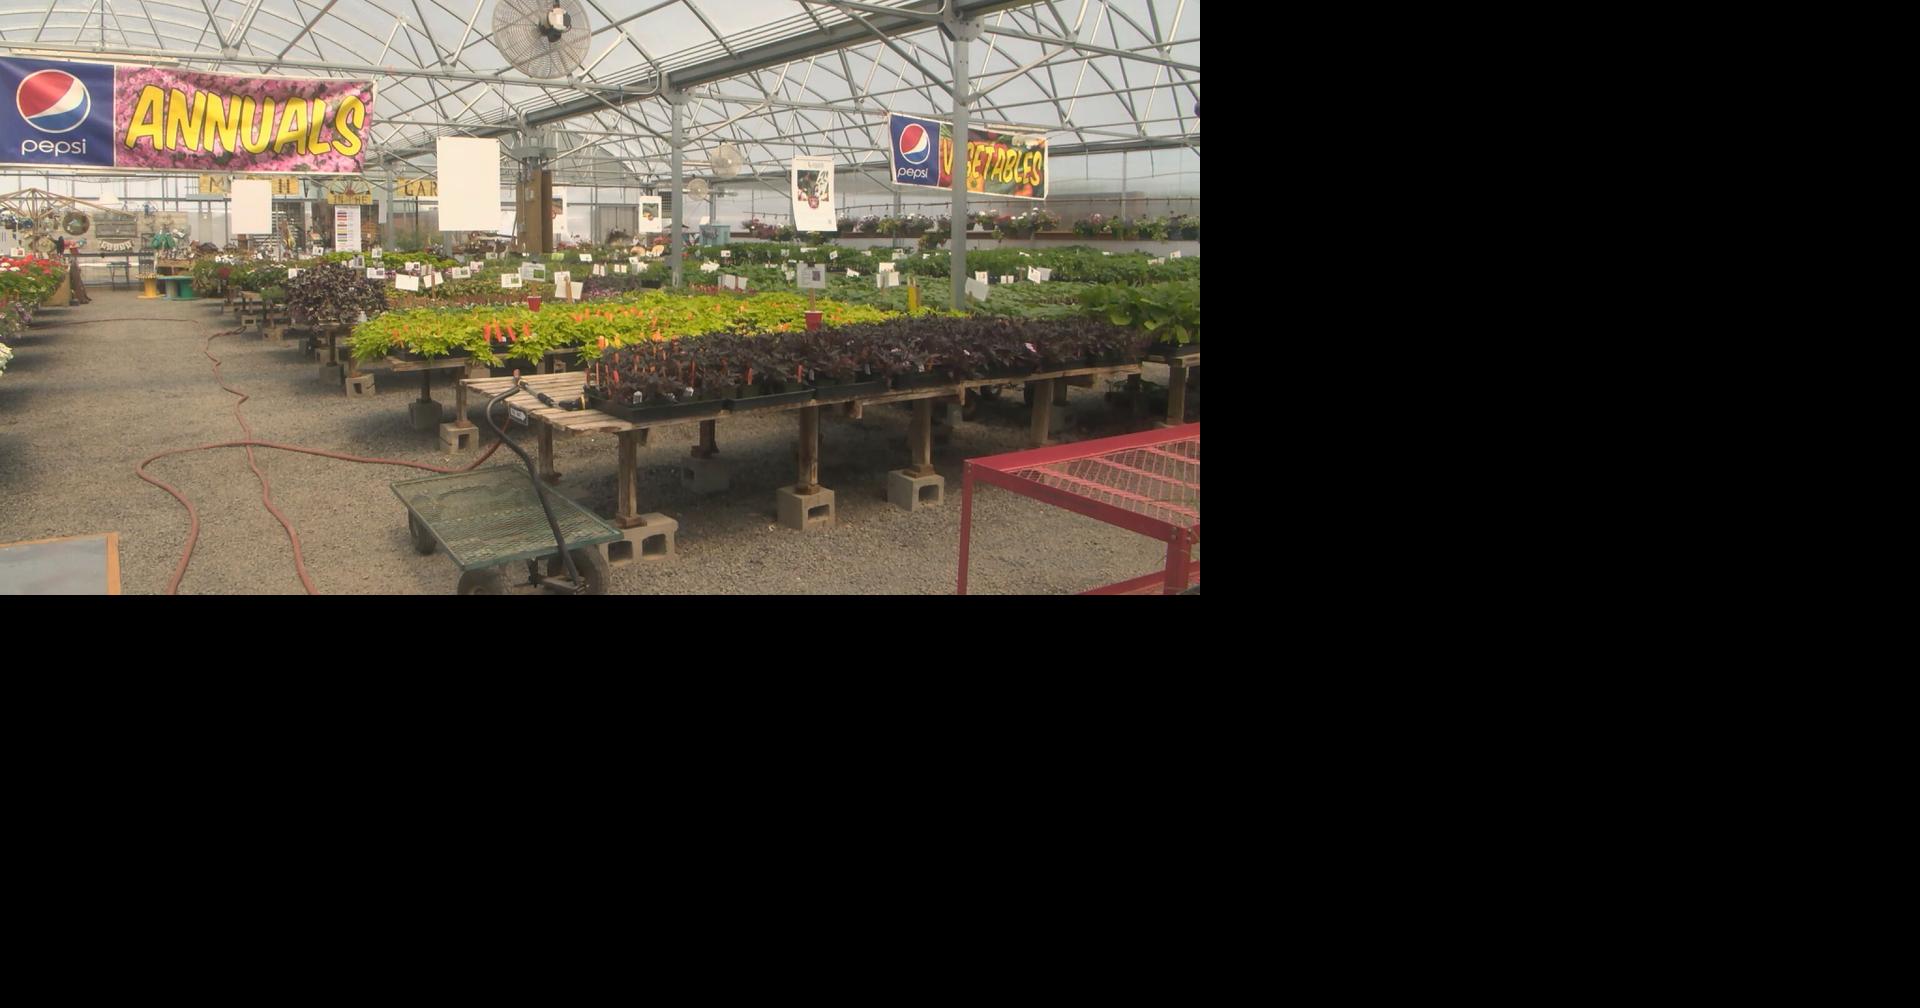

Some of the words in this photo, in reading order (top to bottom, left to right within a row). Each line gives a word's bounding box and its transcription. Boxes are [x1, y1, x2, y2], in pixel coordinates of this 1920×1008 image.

[125, 84, 366, 156] ANNUALS
[21, 138, 86, 157] pepsi
[943, 138, 1042, 186] VGETABLES
[897, 167, 928, 180] pepsi
